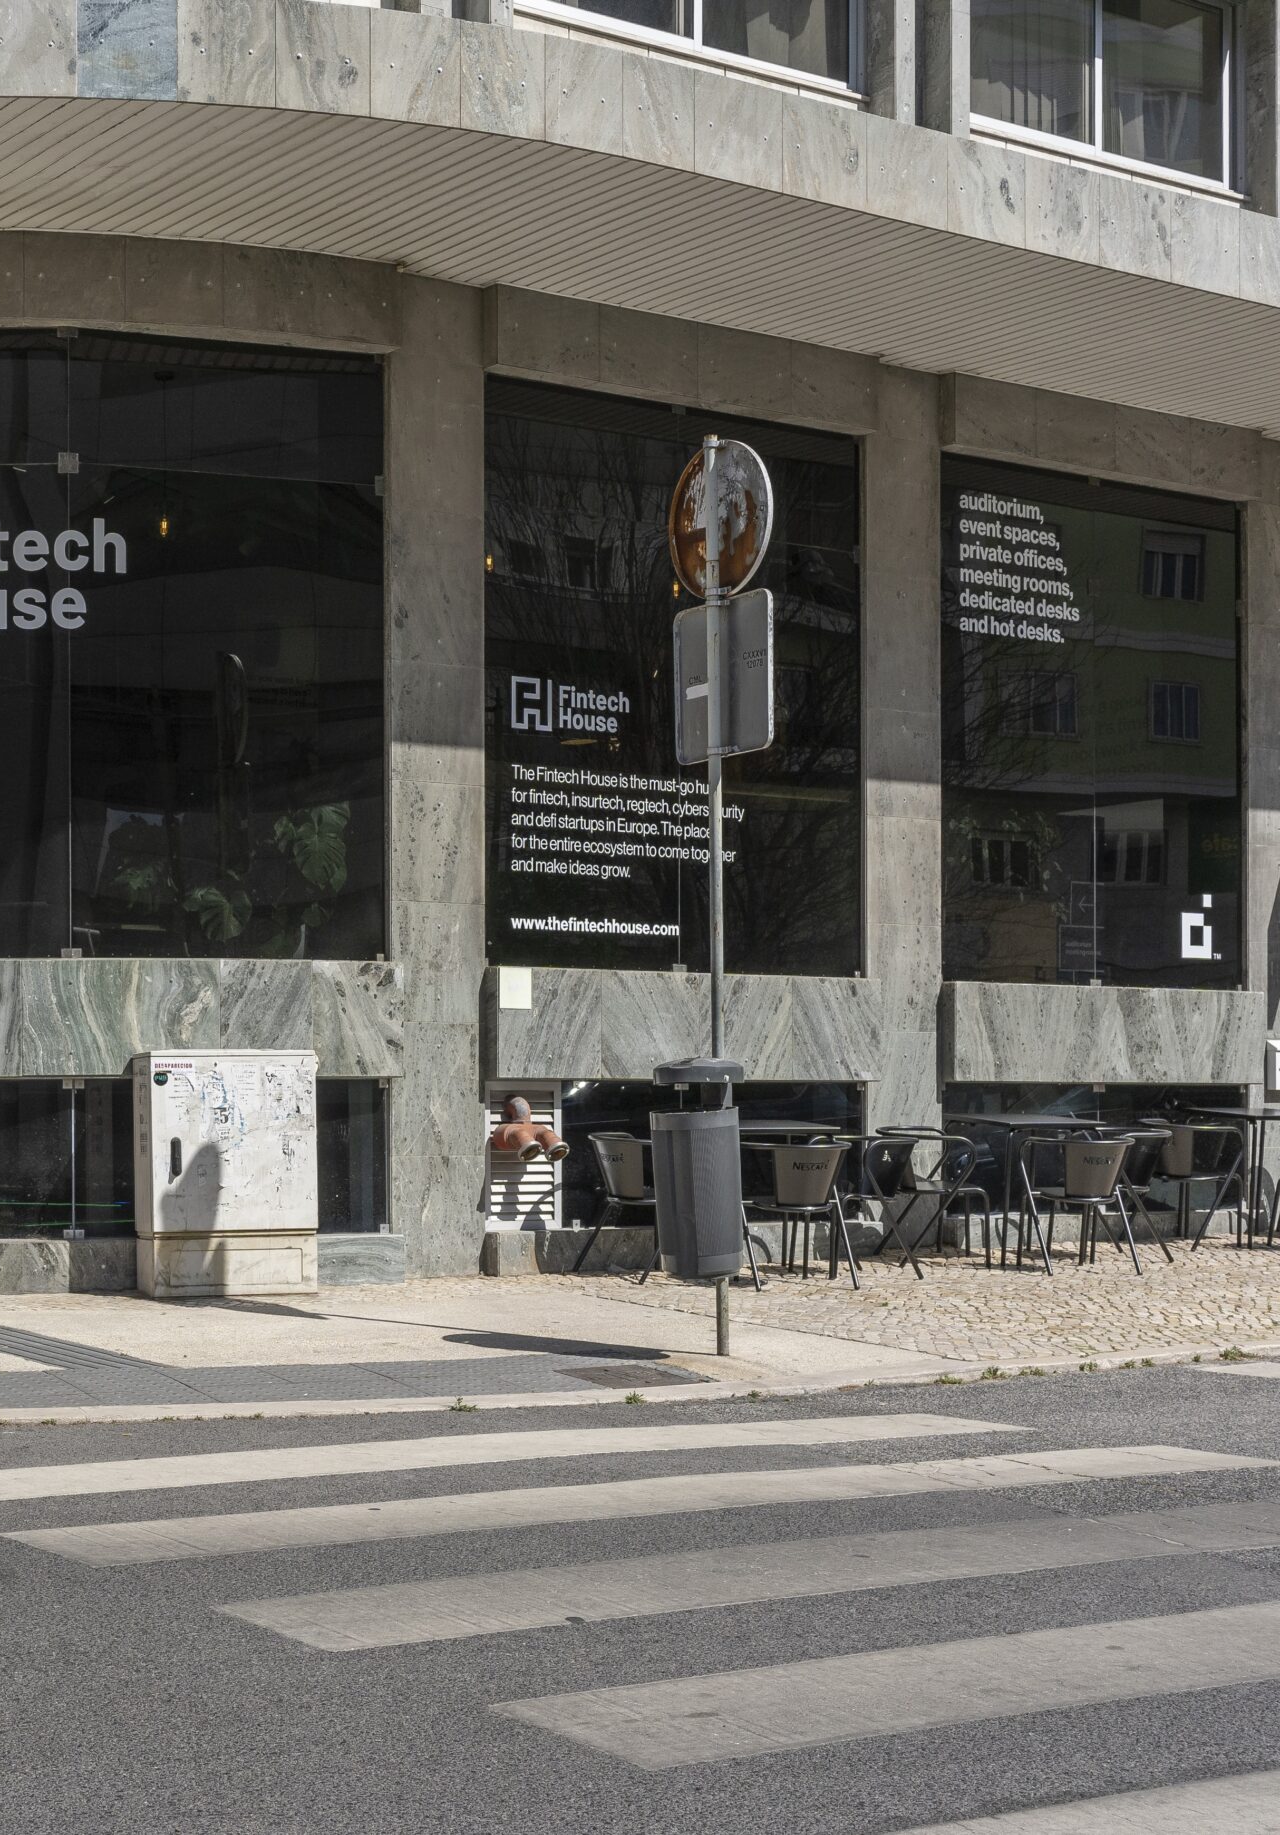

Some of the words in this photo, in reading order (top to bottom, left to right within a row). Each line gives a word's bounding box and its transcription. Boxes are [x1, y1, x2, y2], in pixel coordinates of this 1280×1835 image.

[959, 493, 1044, 524] auditorium,
[959, 518, 1002, 538] event
[1003, 525, 1060, 551] spaces,
[959, 541, 1012, 561] private
[1014, 548, 1067, 576] offices,
[959, 567, 1020, 593] meeting
[1023, 576, 1074, 600] rooms,
[959, 588, 1035, 616] dedicated
[1036, 599, 1080, 622] desks
[959, 615, 988, 633] and
[990, 616, 1015, 637] hot
[1016, 620, 1065, 643] desks.
[559, 685, 630, 713] Fintech
[559, 706, 618, 733] House
[512, 764, 535, 781] The
[536, 766, 579, 785] Fintech
[581, 770, 618, 787] House
[619, 773, 628, 788] is
[630, 774, 648, 790] the
[649, 778, 694, 796] must-go
[696, 780, 709, 795] hu
[511, 787, 528, 803] for
[529, 788, 570, 808] fintech,
[571, 792, 626, 812] insurtech,
[626, 799, 671, 815] regtech,
[672, 801, 745, 822] cybersurity
[511, 811, 533, 827] and
[535, 812, 557, 828] defi
[558, 815, 604, 833] startups
[606, 817, 616, 833] in
[617, 818, 659, 836] Europe.
[661, 821, 683, 837] The
[511, 833, 528, 849] for
[529, 834, 548, 850] the
[549, 837, 581, 853] entire
[583, 840, 644, 858] ecosystem
[646, 842, 657, 858] to
[658, 845, 690, 860] come
[691, 845, 736, 864] togher
[511, 857, 533, 872] and
[535, 859, 568, 874] make
[569, 859, 600, 876] ideas
[600, 865, 630, 879] grow.
[511, 915, 680, 936] www.thefintechhouse.com
